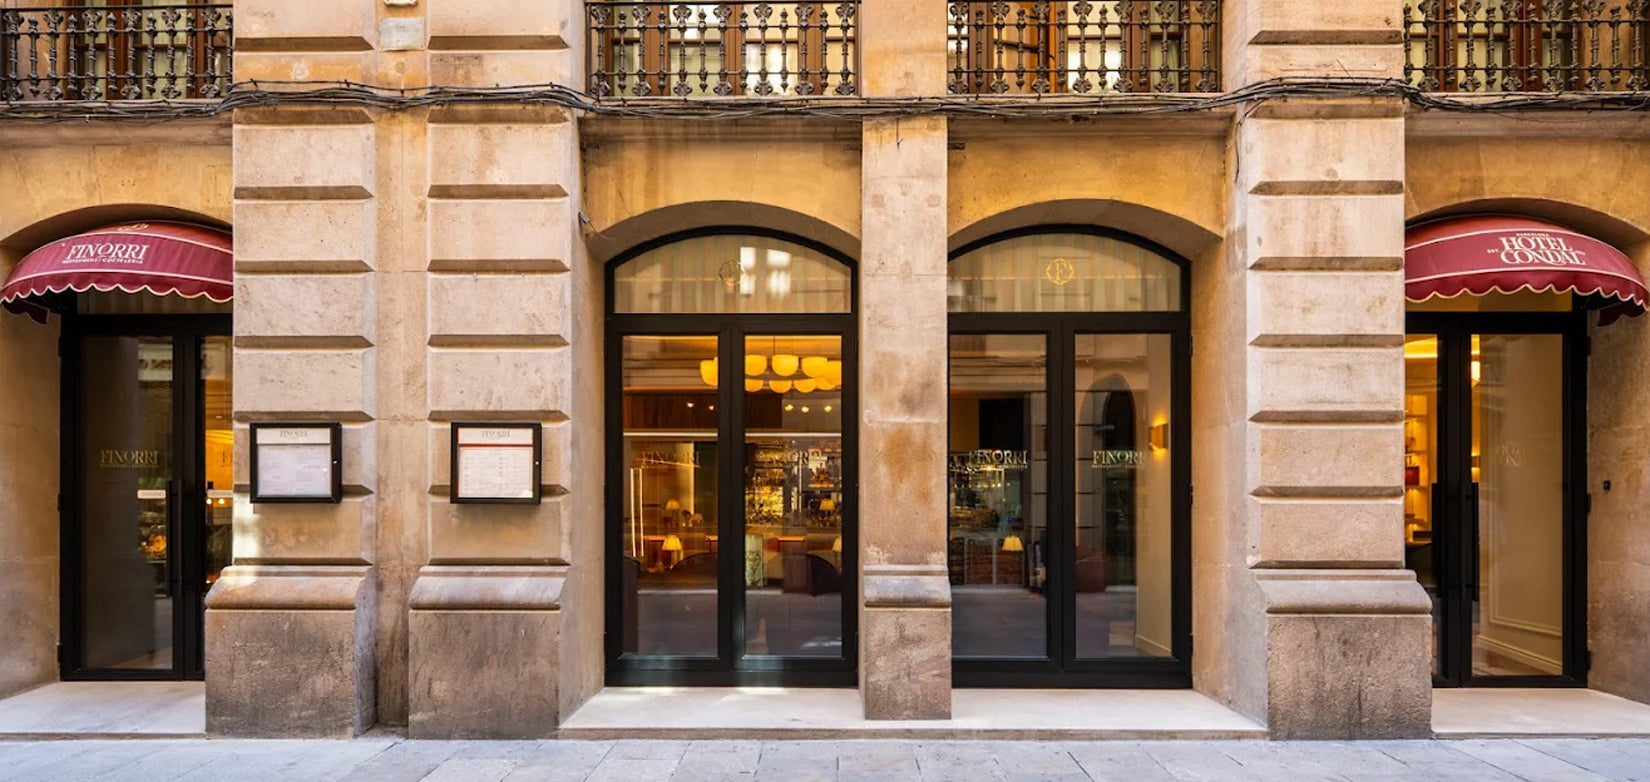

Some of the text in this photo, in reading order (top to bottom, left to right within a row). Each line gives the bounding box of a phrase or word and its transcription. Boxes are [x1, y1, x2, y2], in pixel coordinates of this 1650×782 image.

[65, 243, 150, 260] FINORRI
[1499, 236, 1573, 252] HOTEL
[1500, 249, 1586, 266] CONDAL
[100, 450, 158, 465] FINORRI
[969, 450, 1028, 465] FINORRI
